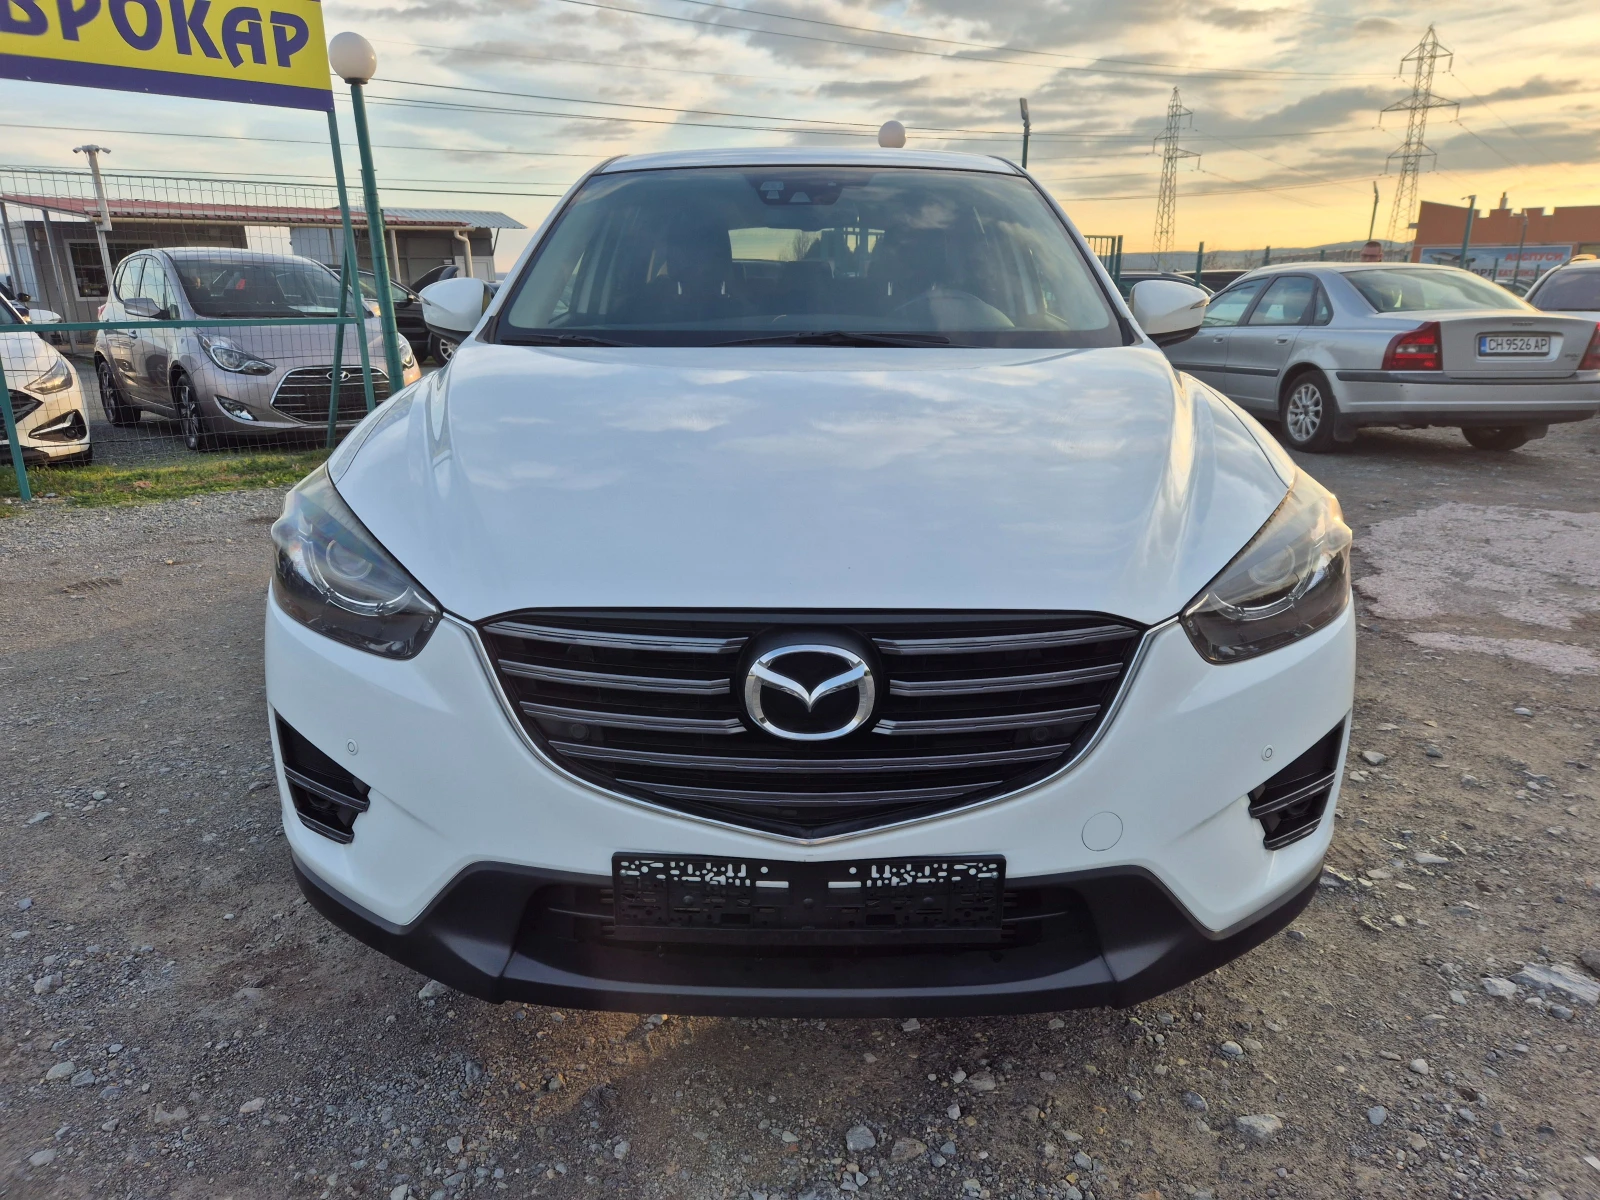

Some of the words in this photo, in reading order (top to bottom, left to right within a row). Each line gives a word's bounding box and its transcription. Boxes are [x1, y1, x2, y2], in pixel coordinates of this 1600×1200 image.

[1489, 338, 1503, 350] CH
[1505, 338, 1532, 350] 9526
[1534, 338, 1548, 350] AP
